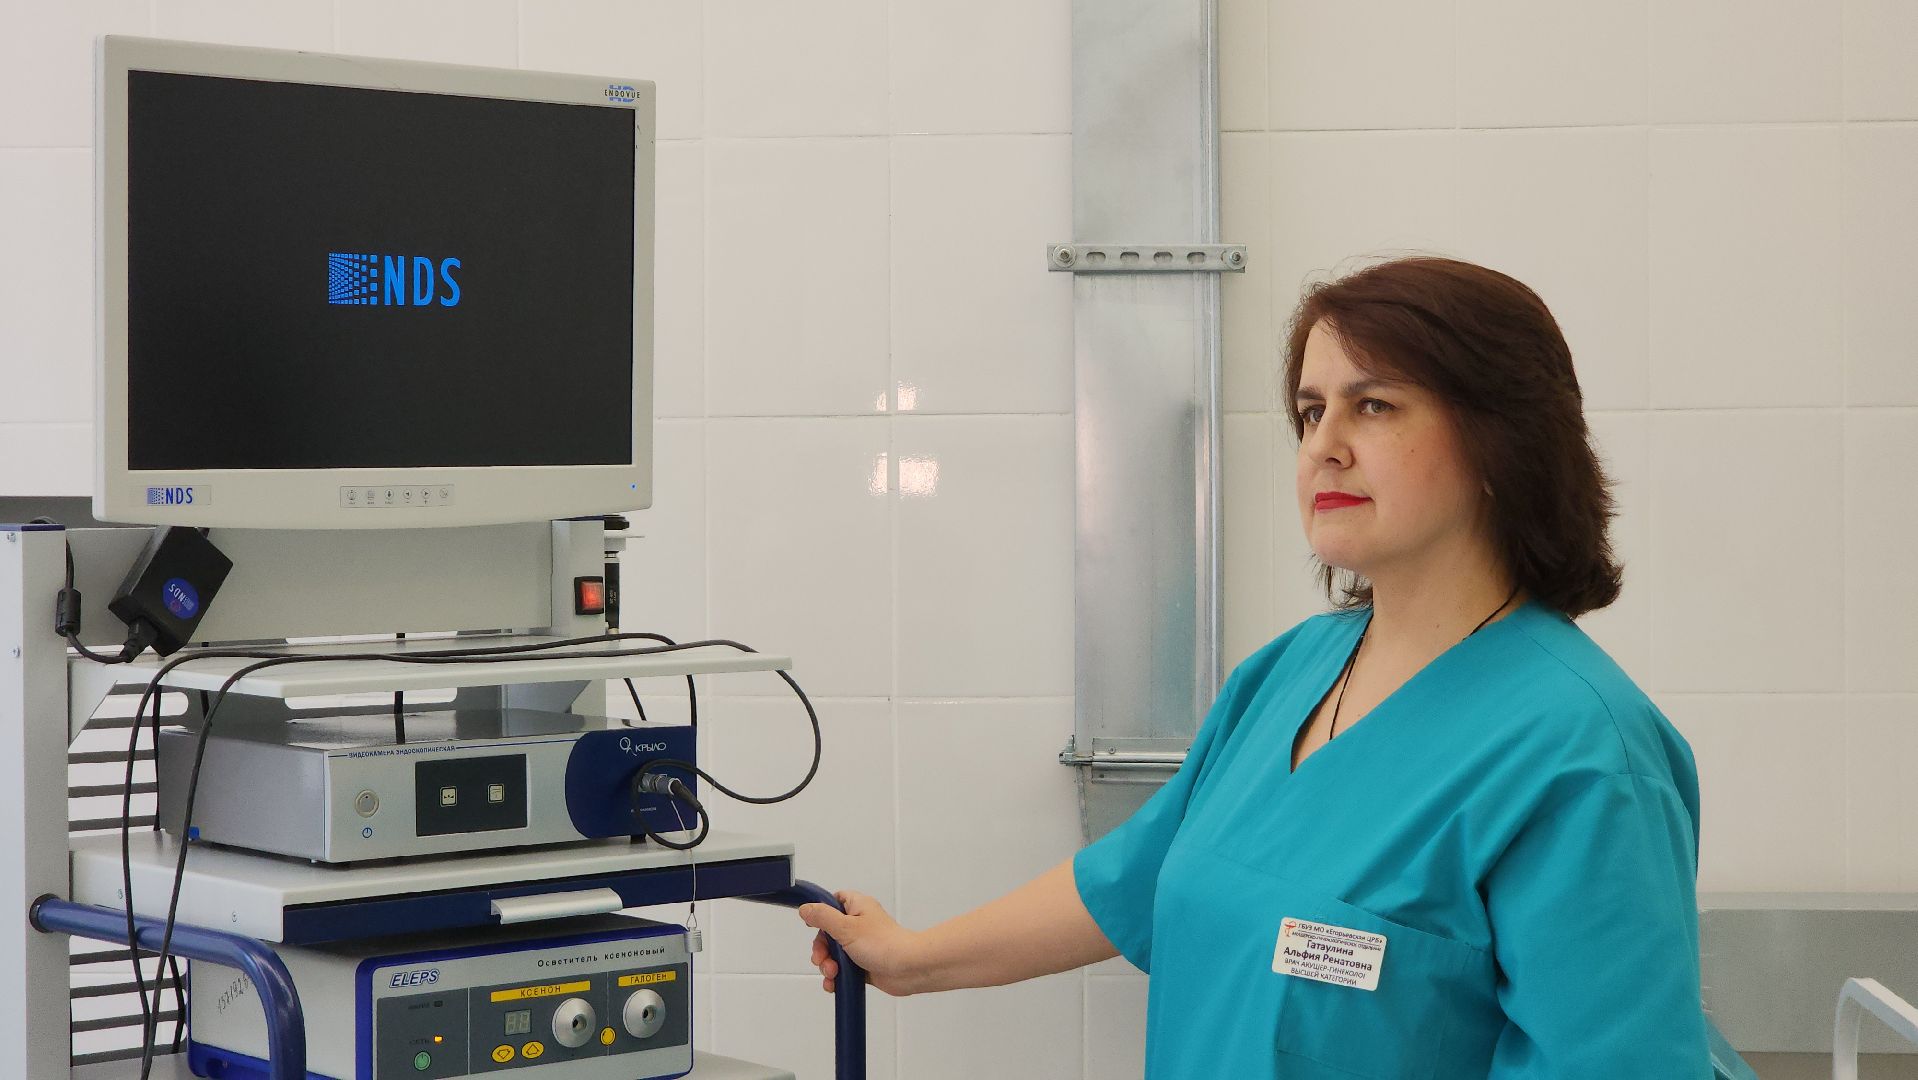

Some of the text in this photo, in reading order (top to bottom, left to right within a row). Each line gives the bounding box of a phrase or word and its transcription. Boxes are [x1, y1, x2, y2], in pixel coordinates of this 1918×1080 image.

[604, 89, 641, 99] ENDOVUE
[384, 255, 461, 307] NDS
[165, 487, 193, 504] NDS
[168, 583, 187, 602] NDS
[348, 745, 456, 759] ВИДЕОКАМЕРА ЭНДОСКОПИЧЕСКАЯ
[635, 742, 667, 753] КРЫЛО
[1298, 922, 1313, 932] ГБУЗ
[1313, 925, 1325, 934] МО
[537, 945, 665, 967] Осветитель ксеноновый
[1306, 939, 1354, 956] Гатаулина
[1283, 946, 1372, 971] Альфия Ренатовна
[389, 968, 440, 988] ELEPS
[630, 973, 667, 984] ГАЛОГЕН
[1290, 967, 1357, 986] ВЫСШЕЙ КАТЕГОРИИ
[520, 985, 561, 998] КСЕНОН
